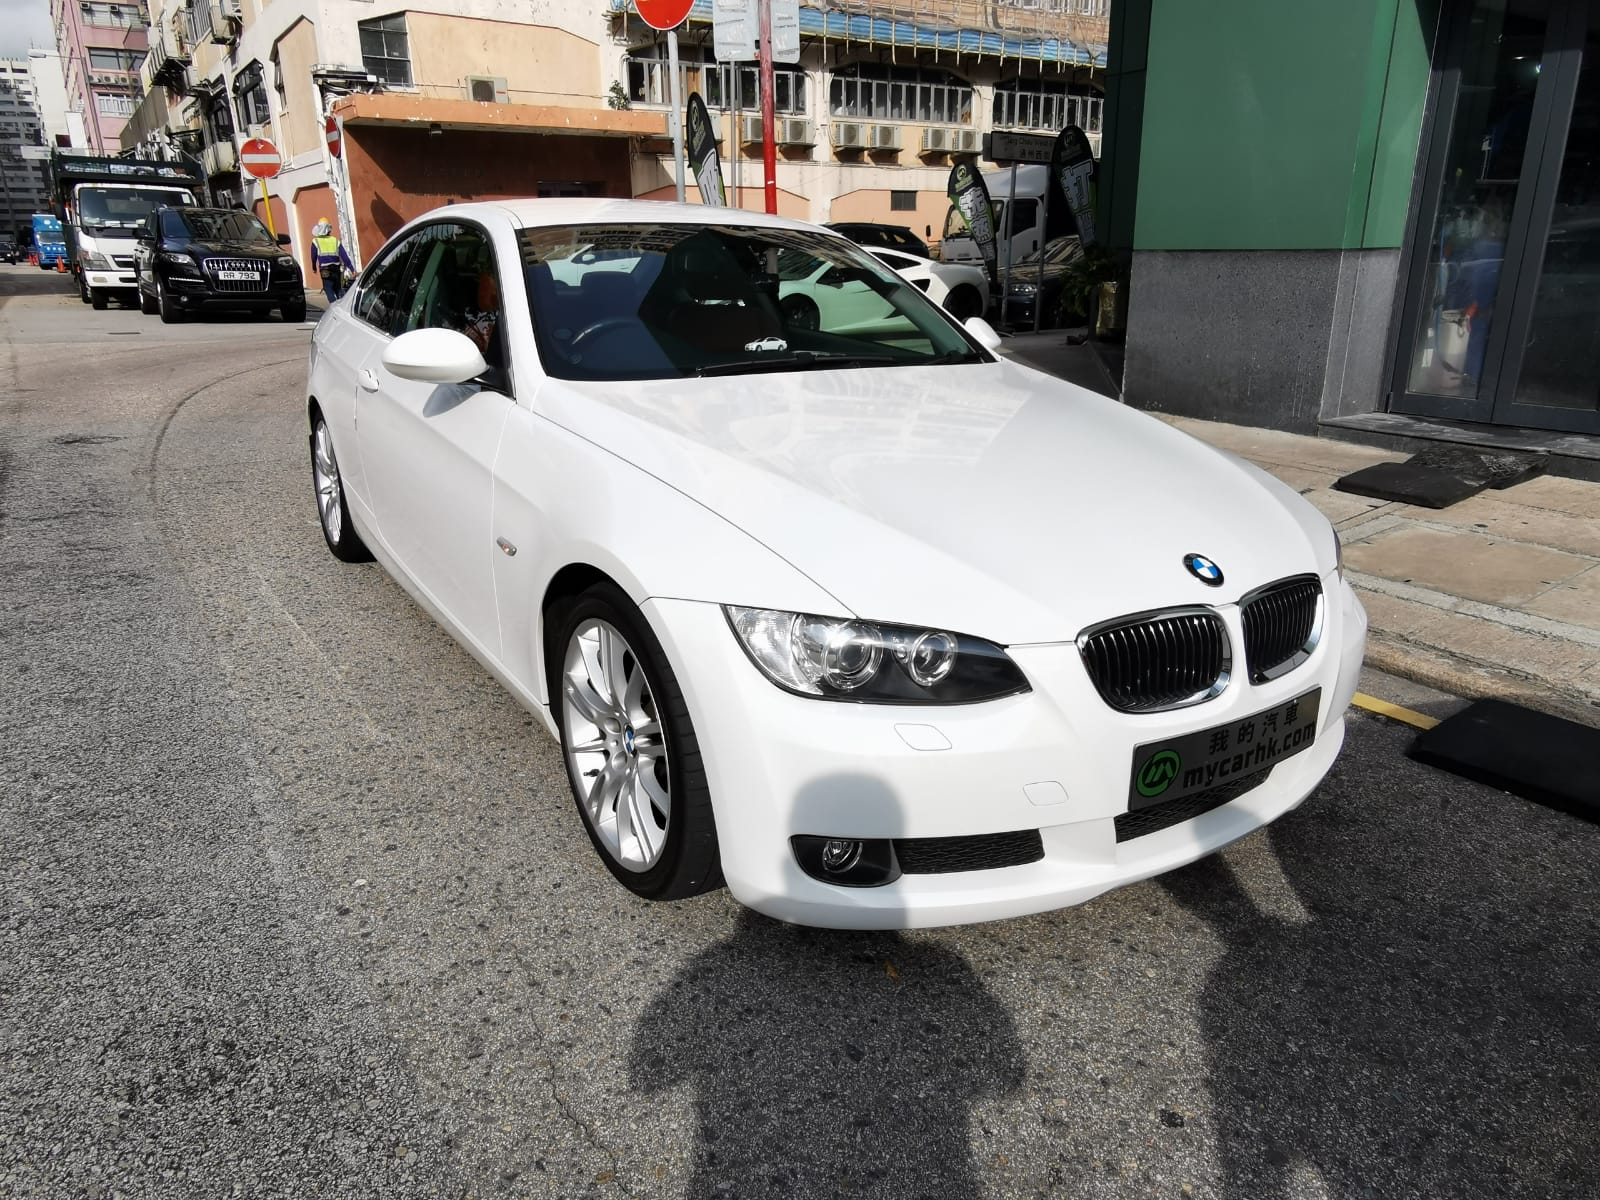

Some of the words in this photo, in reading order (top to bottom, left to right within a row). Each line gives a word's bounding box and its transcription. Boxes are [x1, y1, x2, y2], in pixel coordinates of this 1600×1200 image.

[238, 272, 256, 280] 792
[1182, 721, 1316, 788] mycarhk.com
[1209, 703, 1299, 755] 我的汽車
